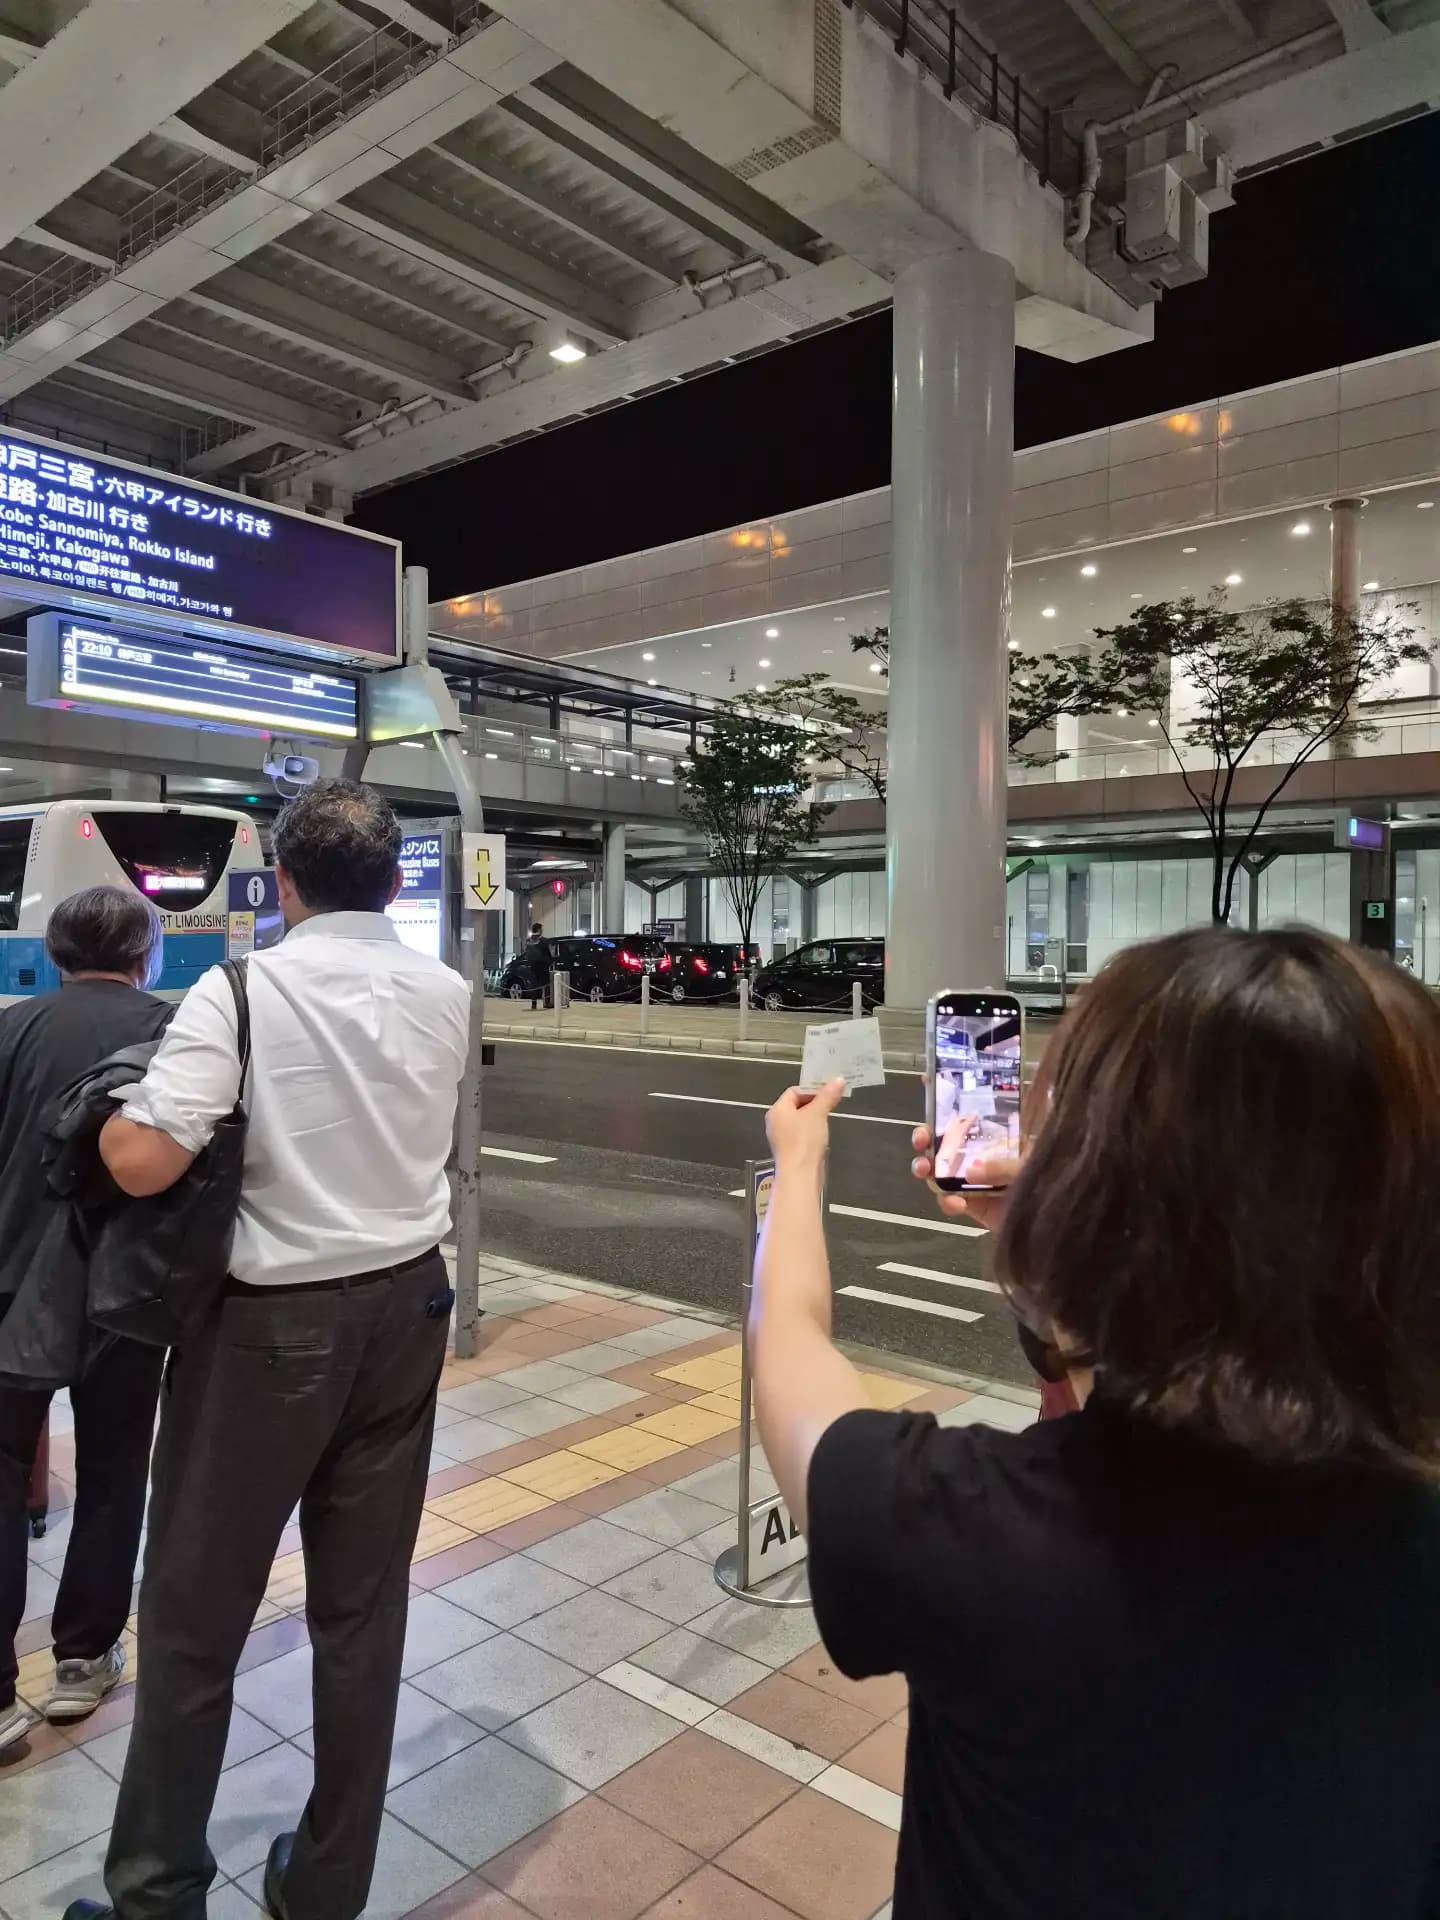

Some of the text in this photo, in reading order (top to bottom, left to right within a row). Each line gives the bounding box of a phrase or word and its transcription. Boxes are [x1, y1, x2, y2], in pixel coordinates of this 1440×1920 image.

[38, 513, 124, 549] Sannomiya,
[128, 535, 171, 559] Rokko
[175, 547, 215, 570] Island
[55, 536, 130, 567] Kakogawa
[81, 641, 112, 657] 22:10
[1371, 904, 1381, 917] 3
[175, 914, 227, 929] LIMOUSINE
